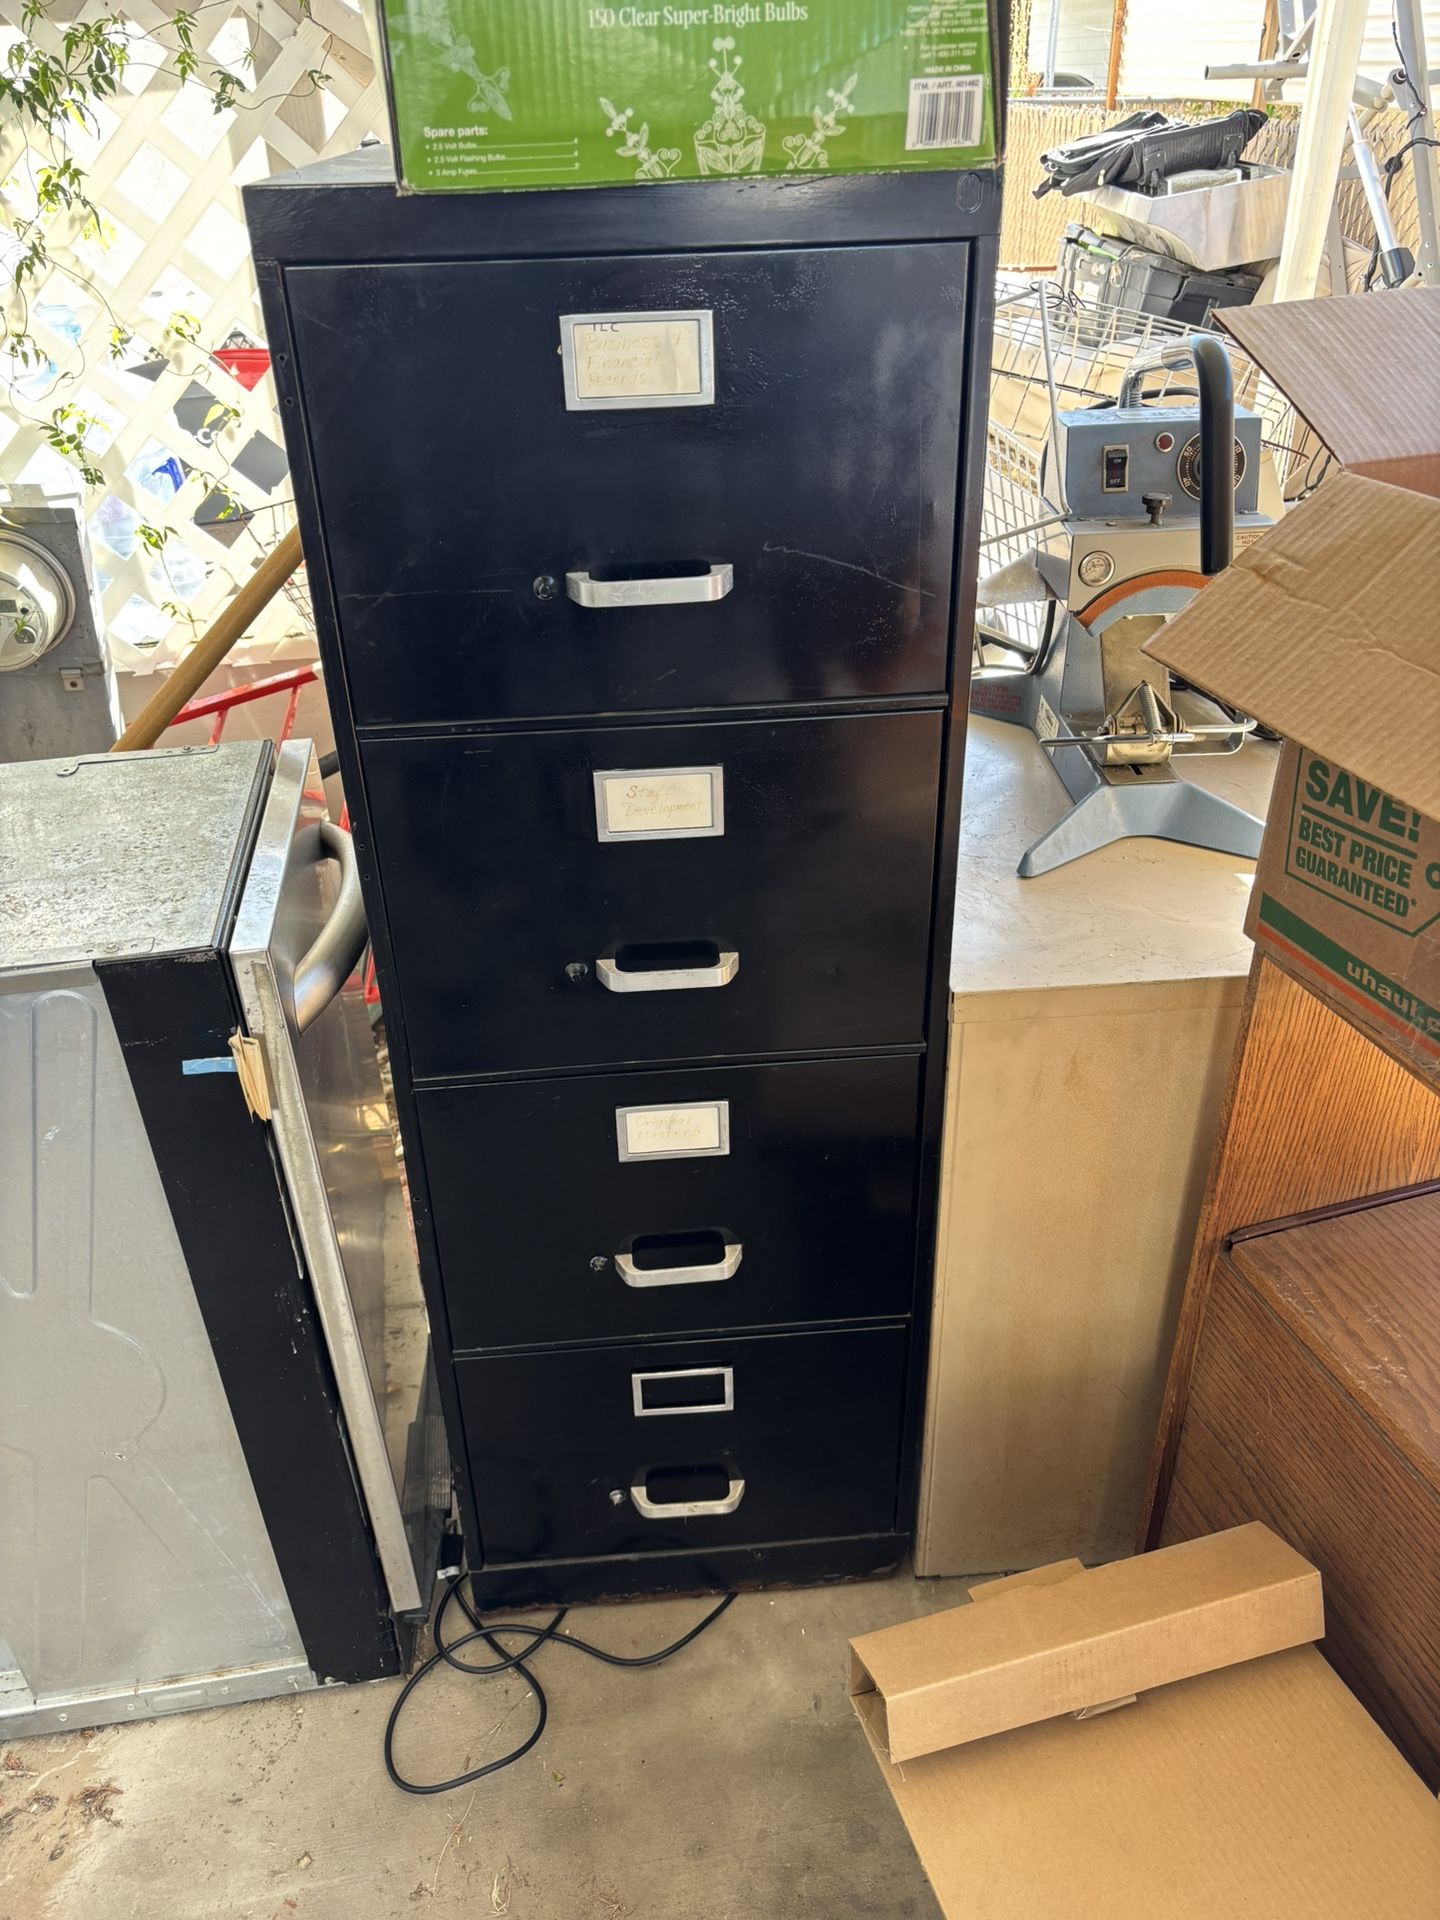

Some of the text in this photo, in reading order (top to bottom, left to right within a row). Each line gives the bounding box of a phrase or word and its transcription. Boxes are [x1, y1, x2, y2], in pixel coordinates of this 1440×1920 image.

[588, 1, 808, 29] 150 Clear Super-Bright Bulbs
[953, 64, 972, 72] CHINA
[424, 125, 488, 139] Spare parts:
[459, 141, 477, 149] Bulbs
[488, 152, 506, 161] Bulbs
[620, 799, 705, 818] Development
[1305, 760, 1422, 843] SAVE!
[1298, 815, 1346, 858] BEST
[1349, 839, 1412, 890] PRICE
